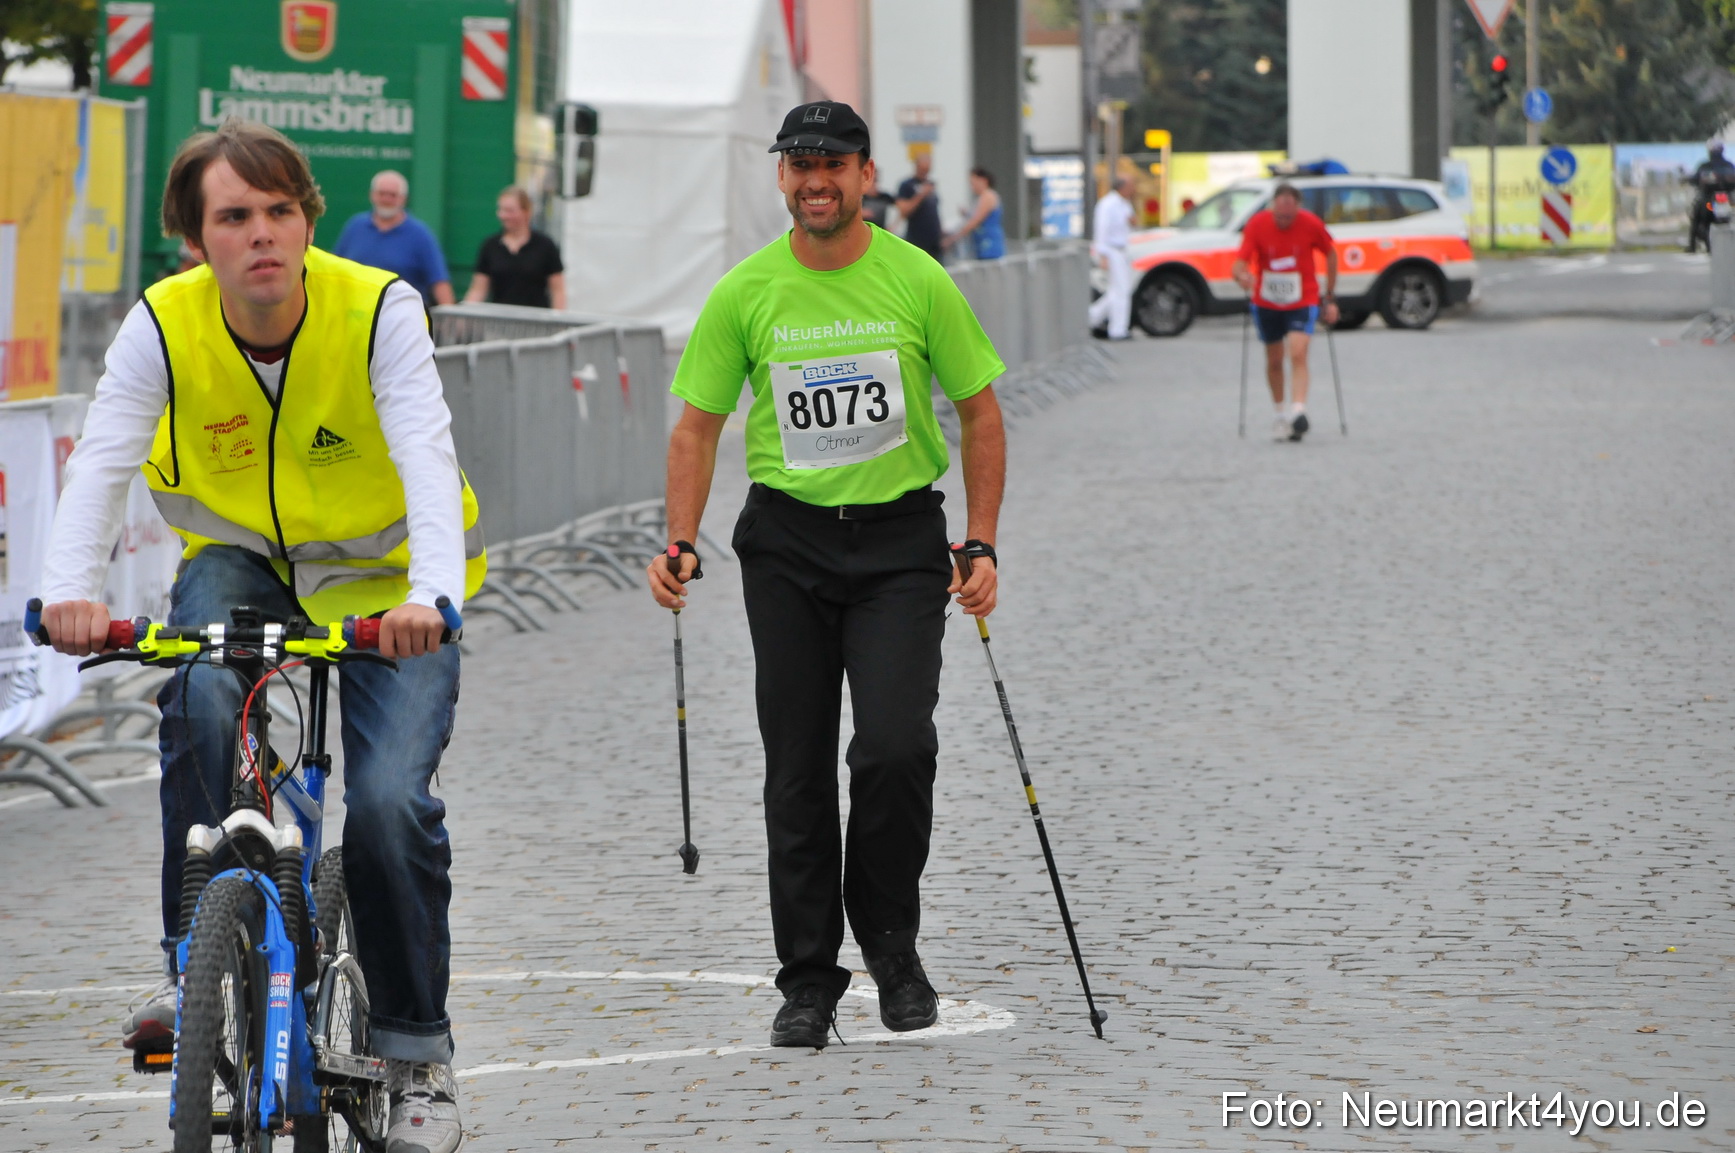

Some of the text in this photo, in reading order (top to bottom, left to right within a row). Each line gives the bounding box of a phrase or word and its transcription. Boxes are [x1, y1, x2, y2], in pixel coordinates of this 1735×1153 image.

[230, 64, 388, 97] Neumarkter
[199, 88, 414, 134] Lammsbräu
[827, 338, 868, 349] WOHNEN.
[802, 362, 859, 381] BOCK
[787, 381, 890, 430] 8073
[204, 414, 248, 431] NEUMARKTER
[815, 434, 864, 452] Otmar
[270, 973, 291, 986] ROCK
[275, 1030, 289, 1081] SID
